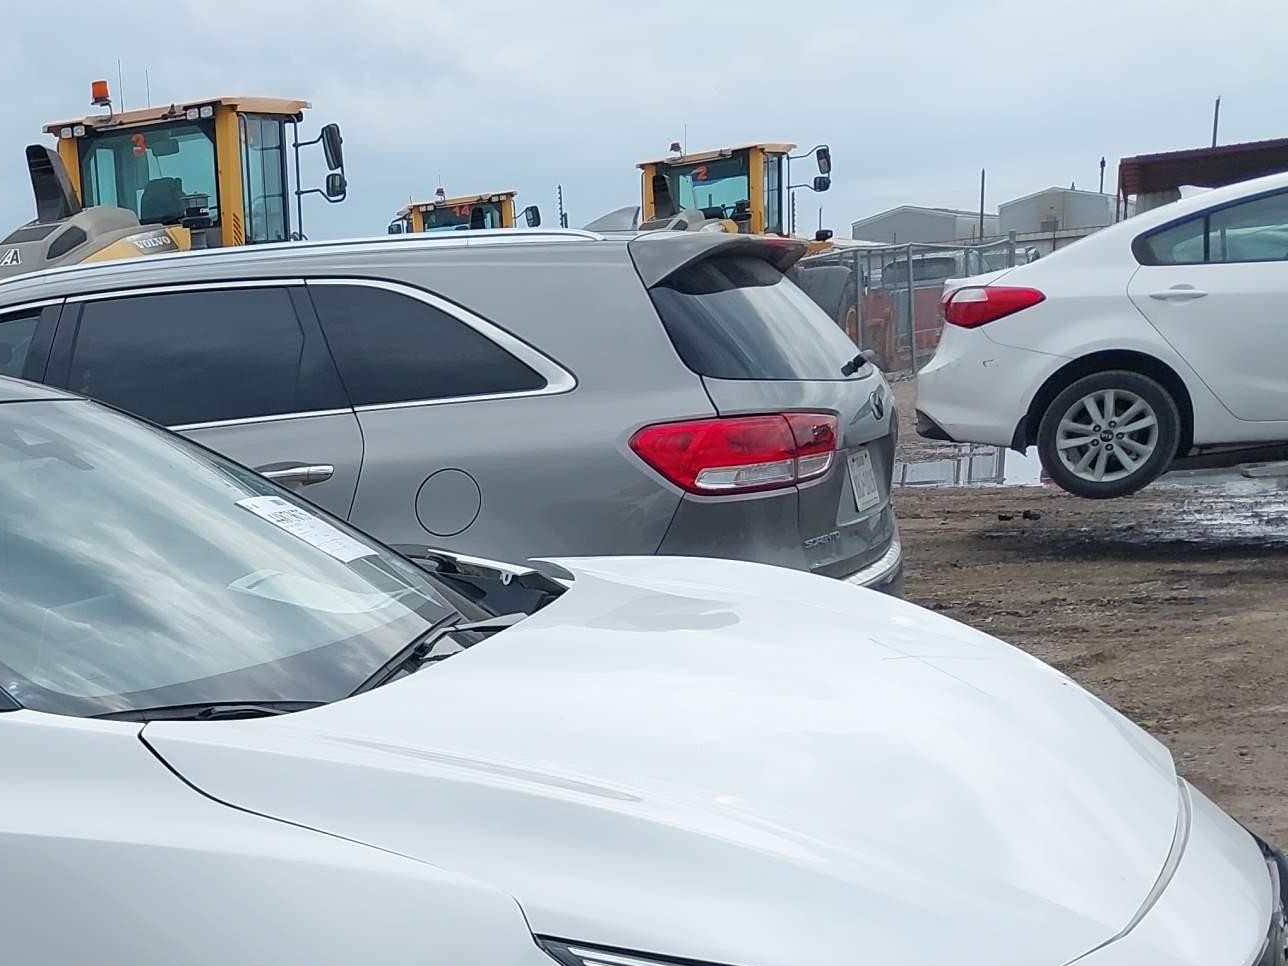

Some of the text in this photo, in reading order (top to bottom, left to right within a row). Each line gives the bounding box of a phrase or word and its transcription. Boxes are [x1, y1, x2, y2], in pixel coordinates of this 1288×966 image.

[130, 133, 147, 157] 3
[695, 164, 709, 181] 2
[452, 204, 471, 217] 14
[135, 235, 171, 249] VOLVO
